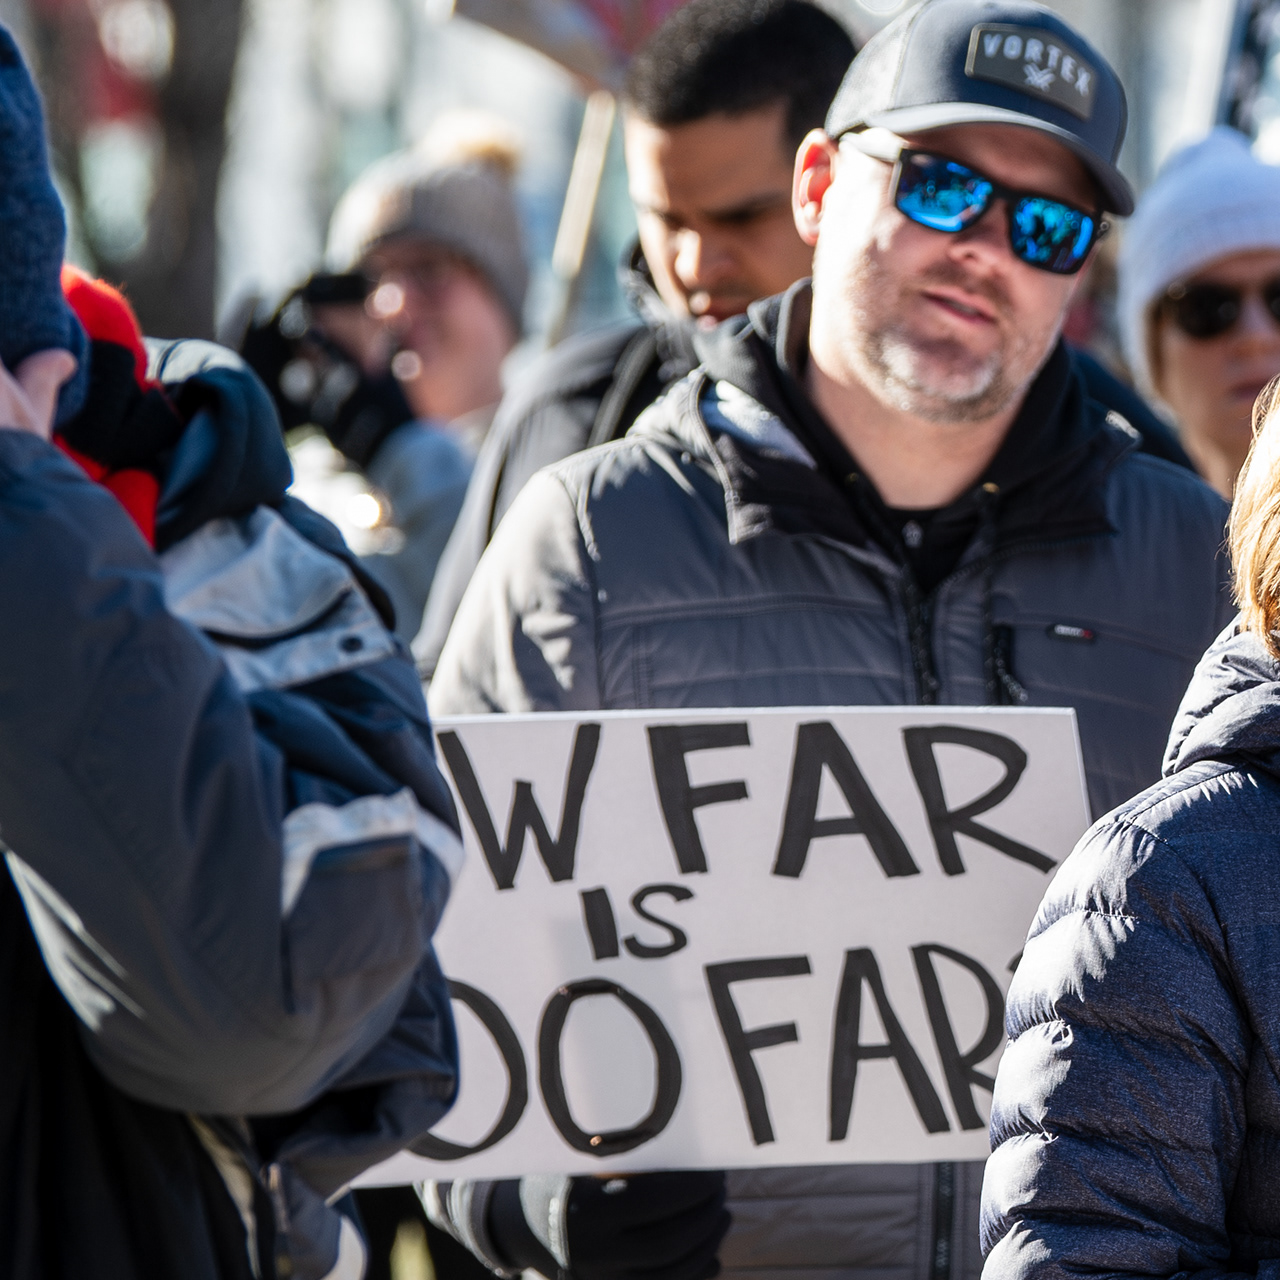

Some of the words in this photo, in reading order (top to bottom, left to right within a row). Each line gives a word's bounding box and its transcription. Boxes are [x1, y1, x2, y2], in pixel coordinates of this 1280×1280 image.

[983, 33, 1091, 97] VORTEX
[647, 721, 1058, 878] FAR
[580, 884, 695, 961] IS
[705, 942, 1023, 1147] FAR
